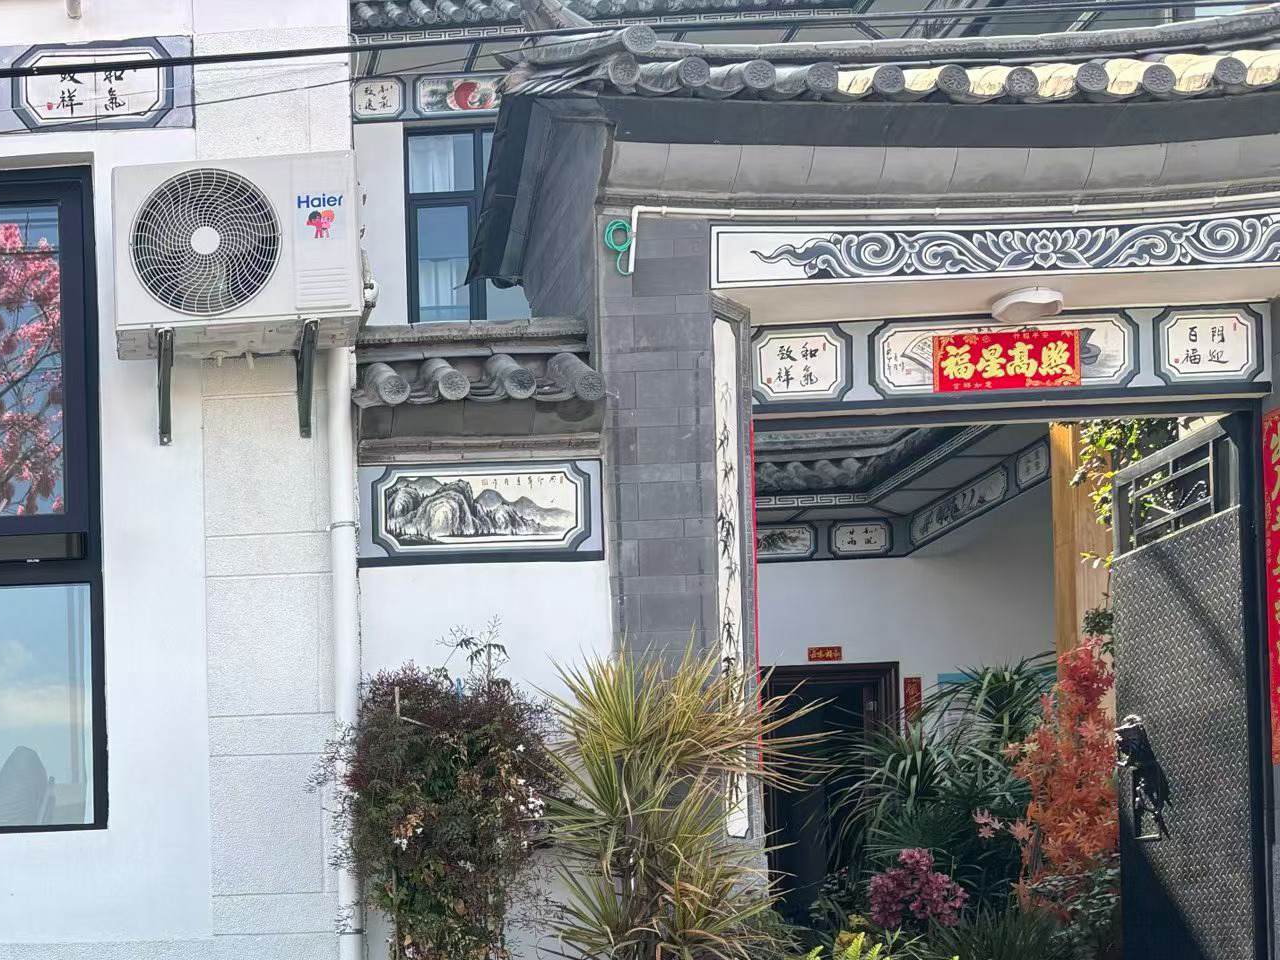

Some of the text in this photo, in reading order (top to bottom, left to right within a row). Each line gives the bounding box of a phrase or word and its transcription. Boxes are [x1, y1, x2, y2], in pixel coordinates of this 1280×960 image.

[297, 193, 343, 209] Haier
[940, 341, 1074, 380] 福星高照
